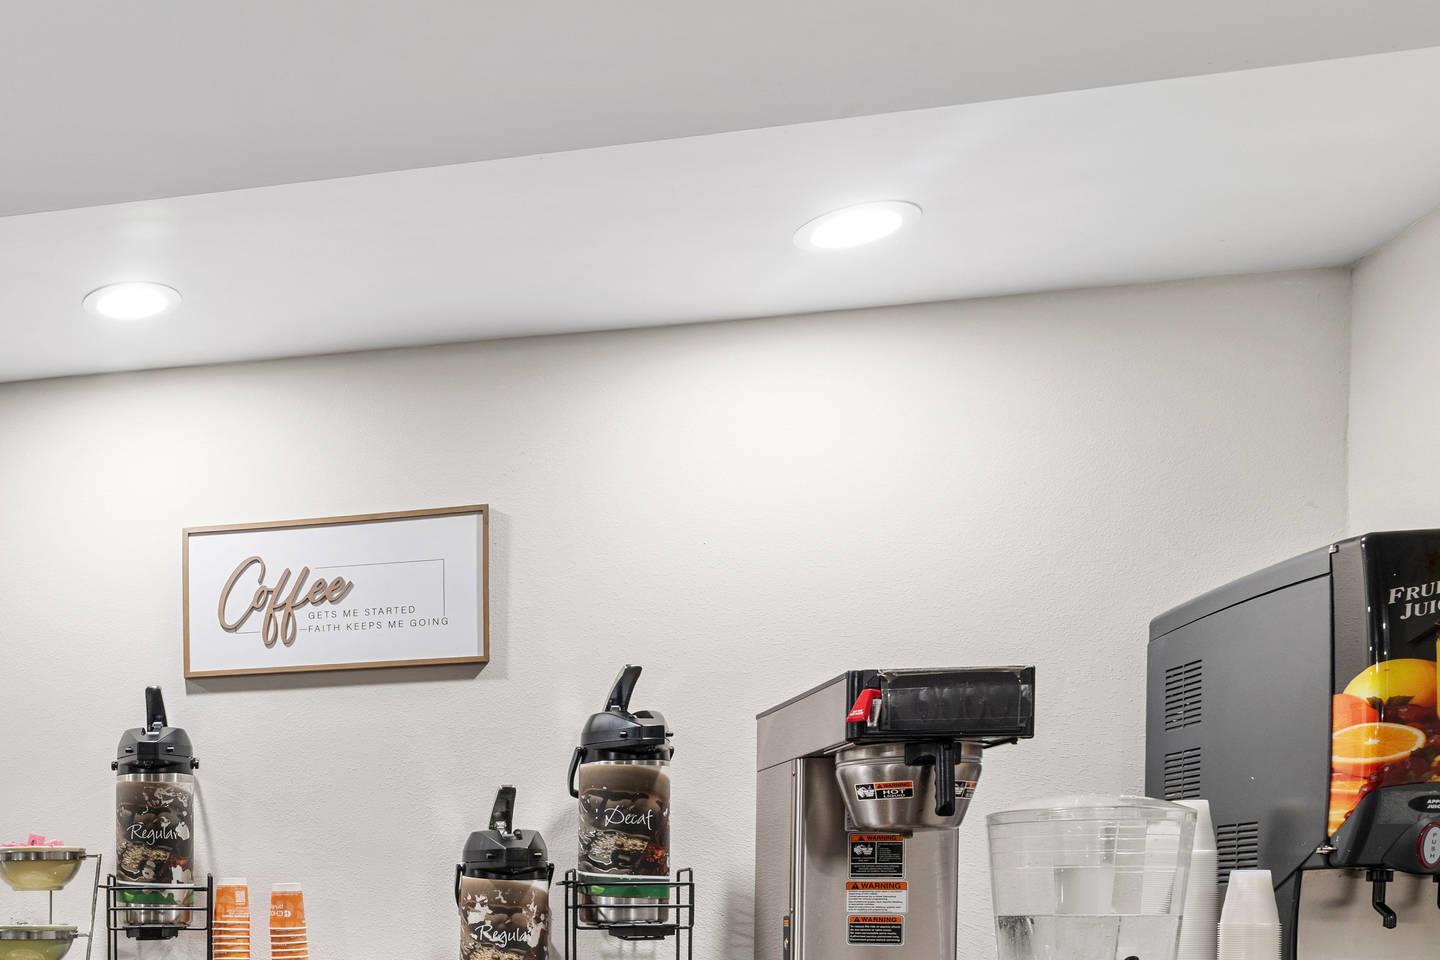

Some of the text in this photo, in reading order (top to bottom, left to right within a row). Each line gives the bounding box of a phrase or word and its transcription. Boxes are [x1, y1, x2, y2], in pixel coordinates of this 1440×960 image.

[218, 556, 354, 648] Coffee
[308, 605, 416, 620] GETS ME STARTED
[1400, 600, 1440, 620] JUI
[308, 617, 449, 633] FAITH KEEPS ME GOING
[604, 805, 653, 831] Decaf
[475, 924, 531, 948] Regula
